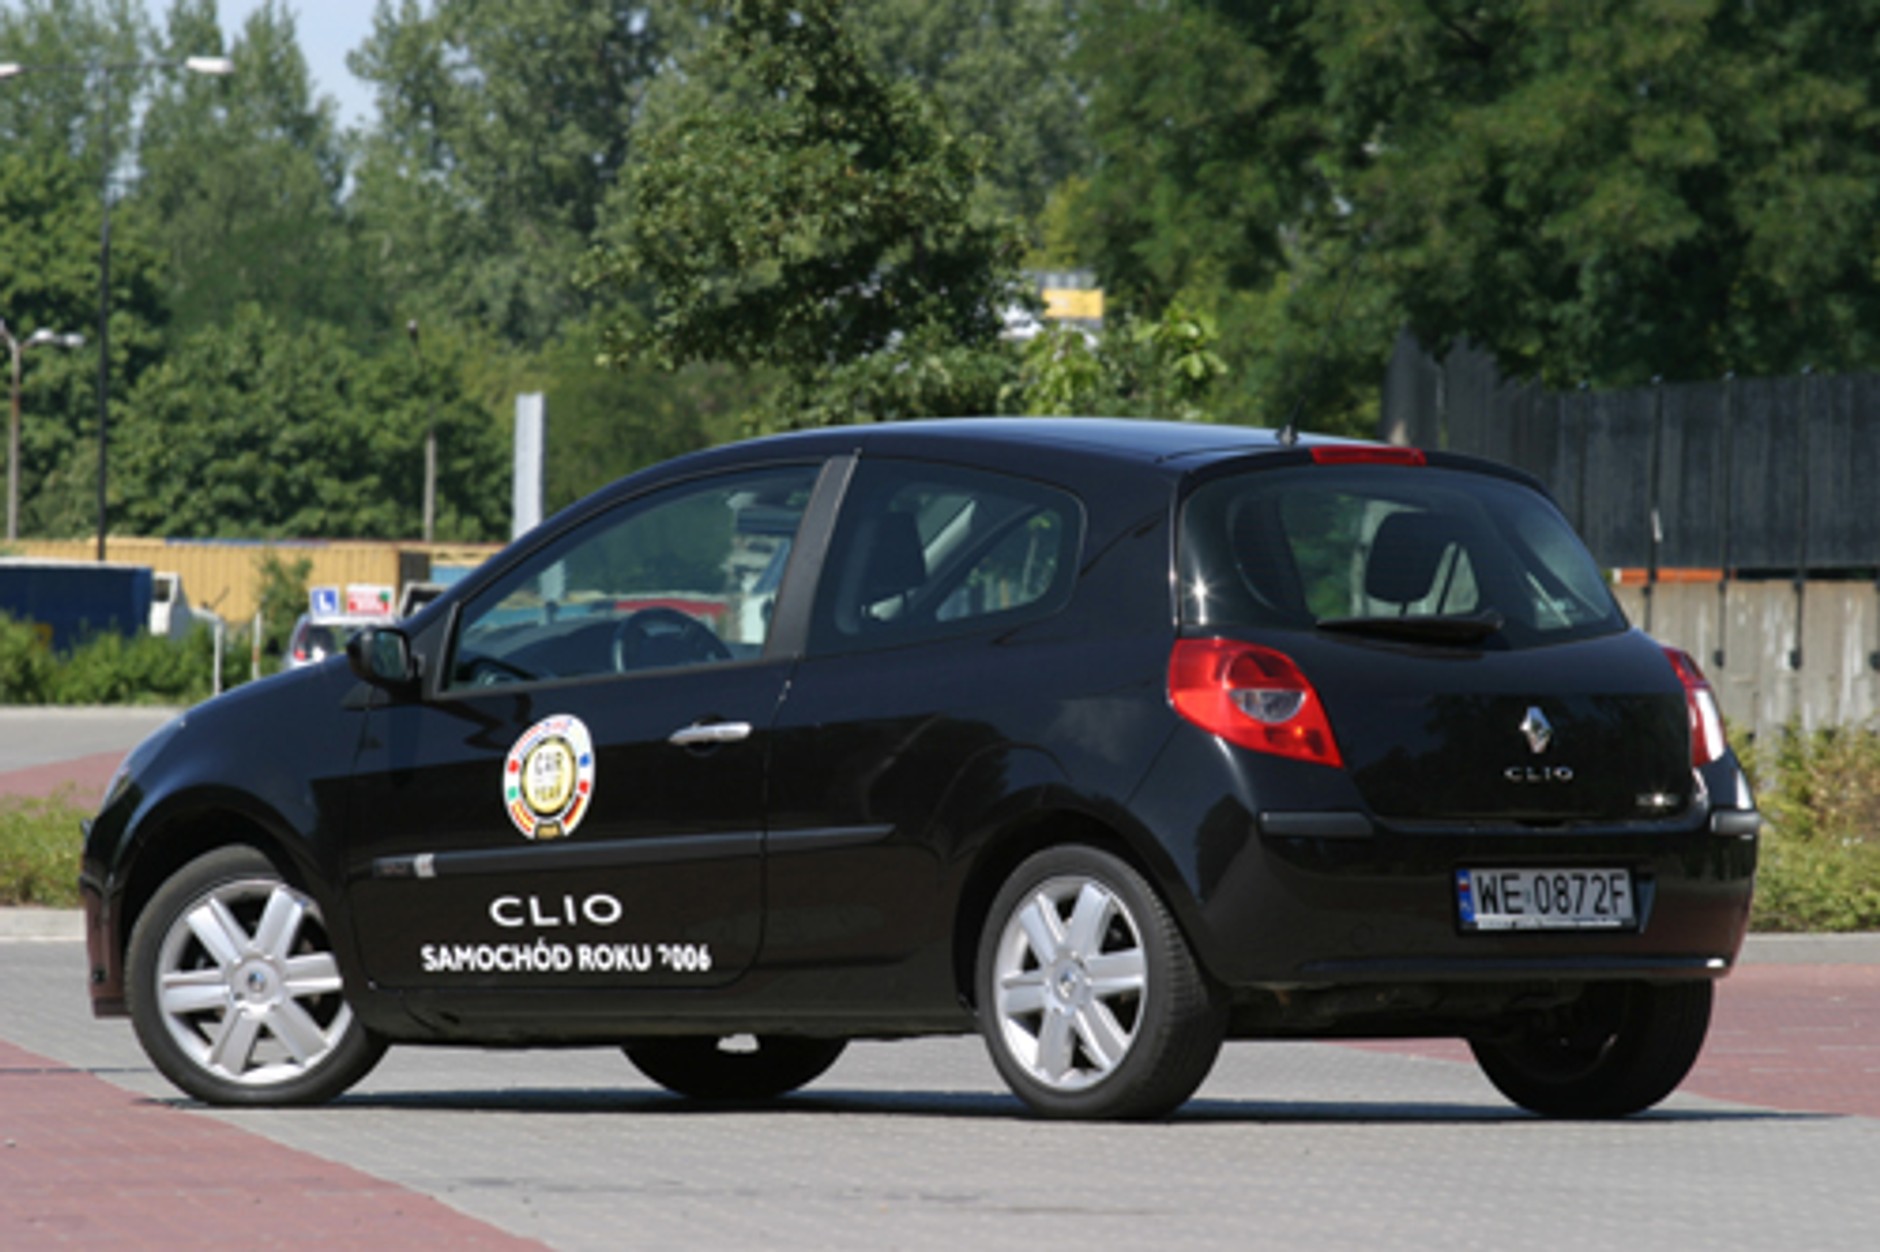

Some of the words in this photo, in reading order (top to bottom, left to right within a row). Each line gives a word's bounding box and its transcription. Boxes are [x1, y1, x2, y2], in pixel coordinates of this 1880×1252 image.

[1503, 766, 1574, 782] CLIO
[489, 893, 622, 926] CLIO
[1475, 873, 1524, 915] WE
[1534, 873, 1625, 915] 0872F
[421, 937, 572, 972] SAMOCHÓD
[577, 944, 652, 972] ROKU
